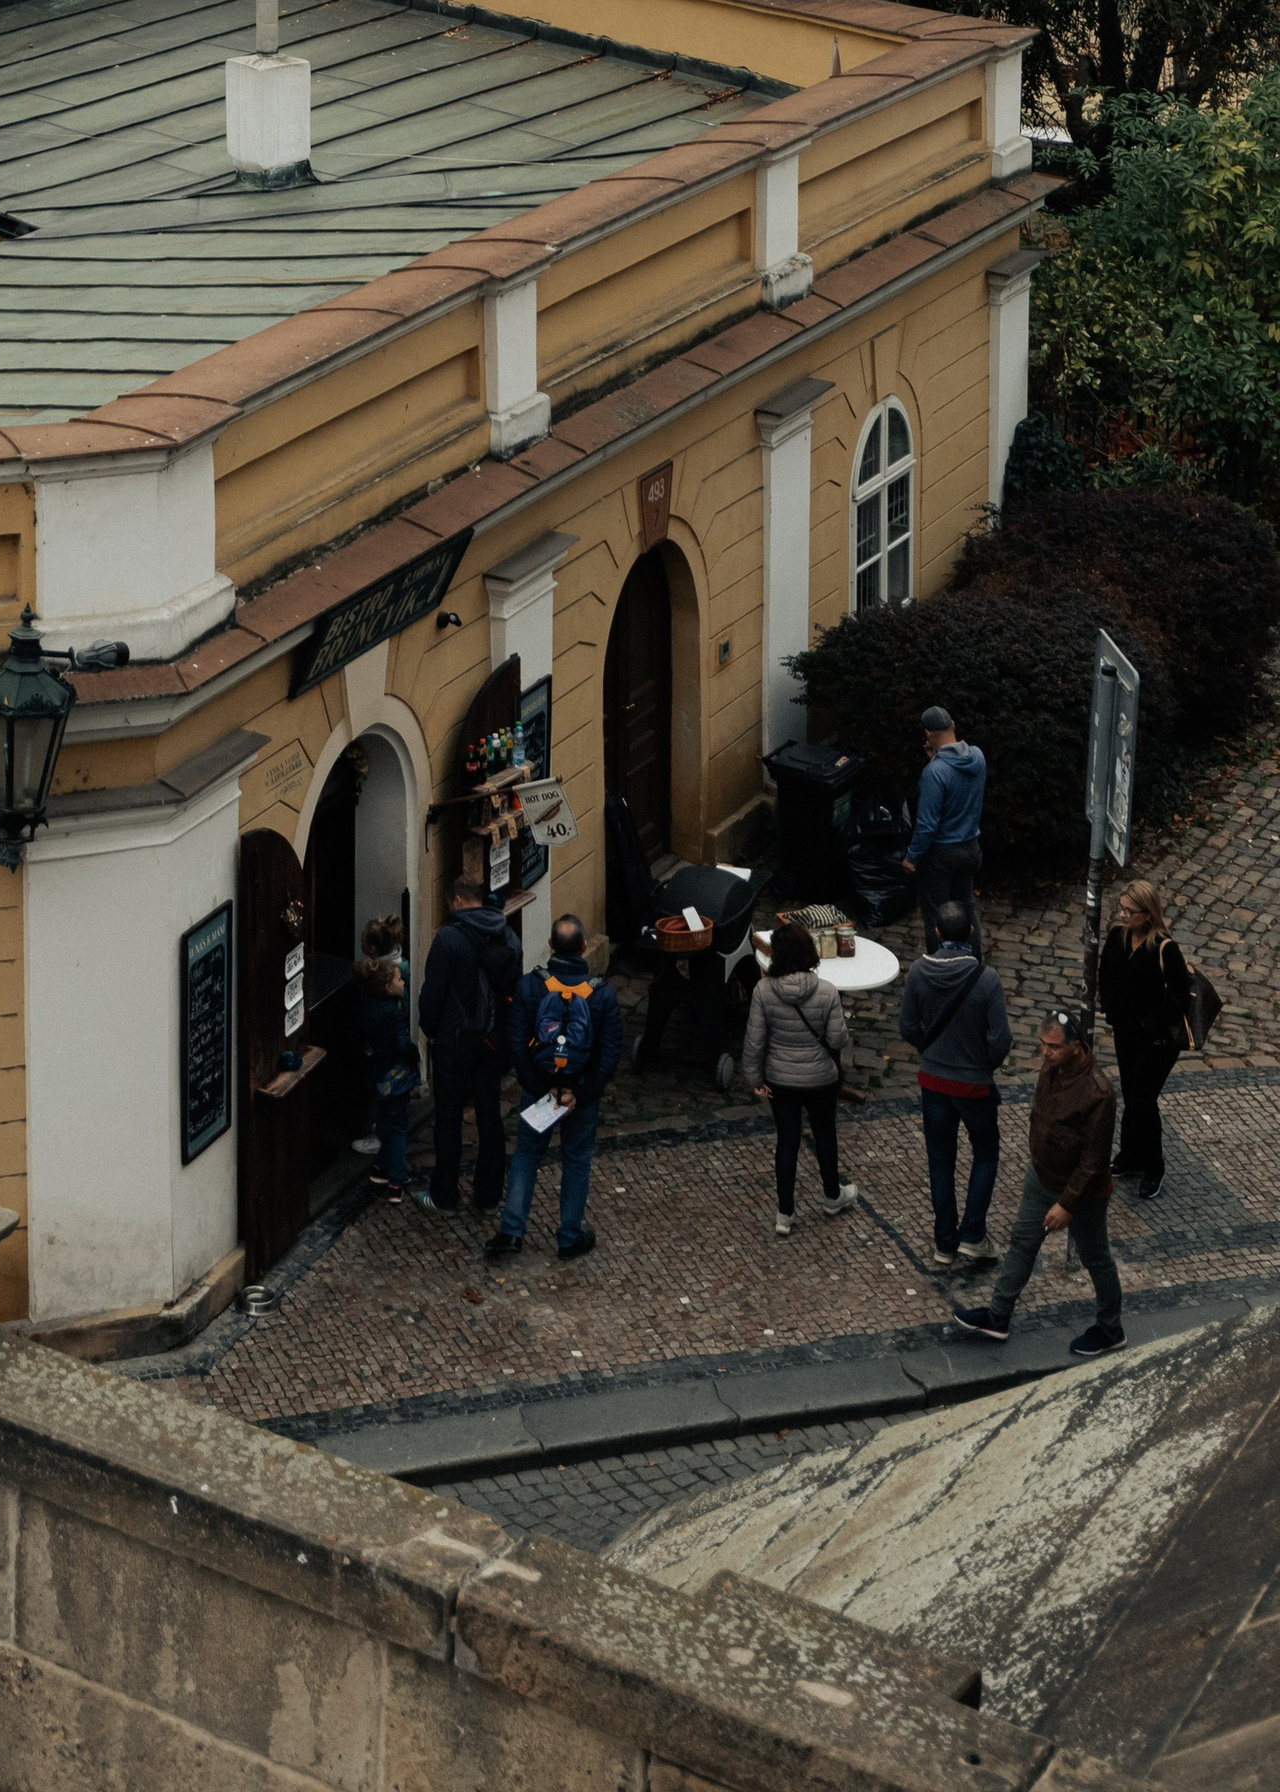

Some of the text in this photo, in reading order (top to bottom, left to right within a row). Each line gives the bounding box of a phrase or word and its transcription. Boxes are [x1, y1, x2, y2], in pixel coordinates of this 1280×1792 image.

[648, 477, 665, 503] 493
[324, 583, 395, 644] BISTRO
[525, 791, 560, 804] HOT DOG
